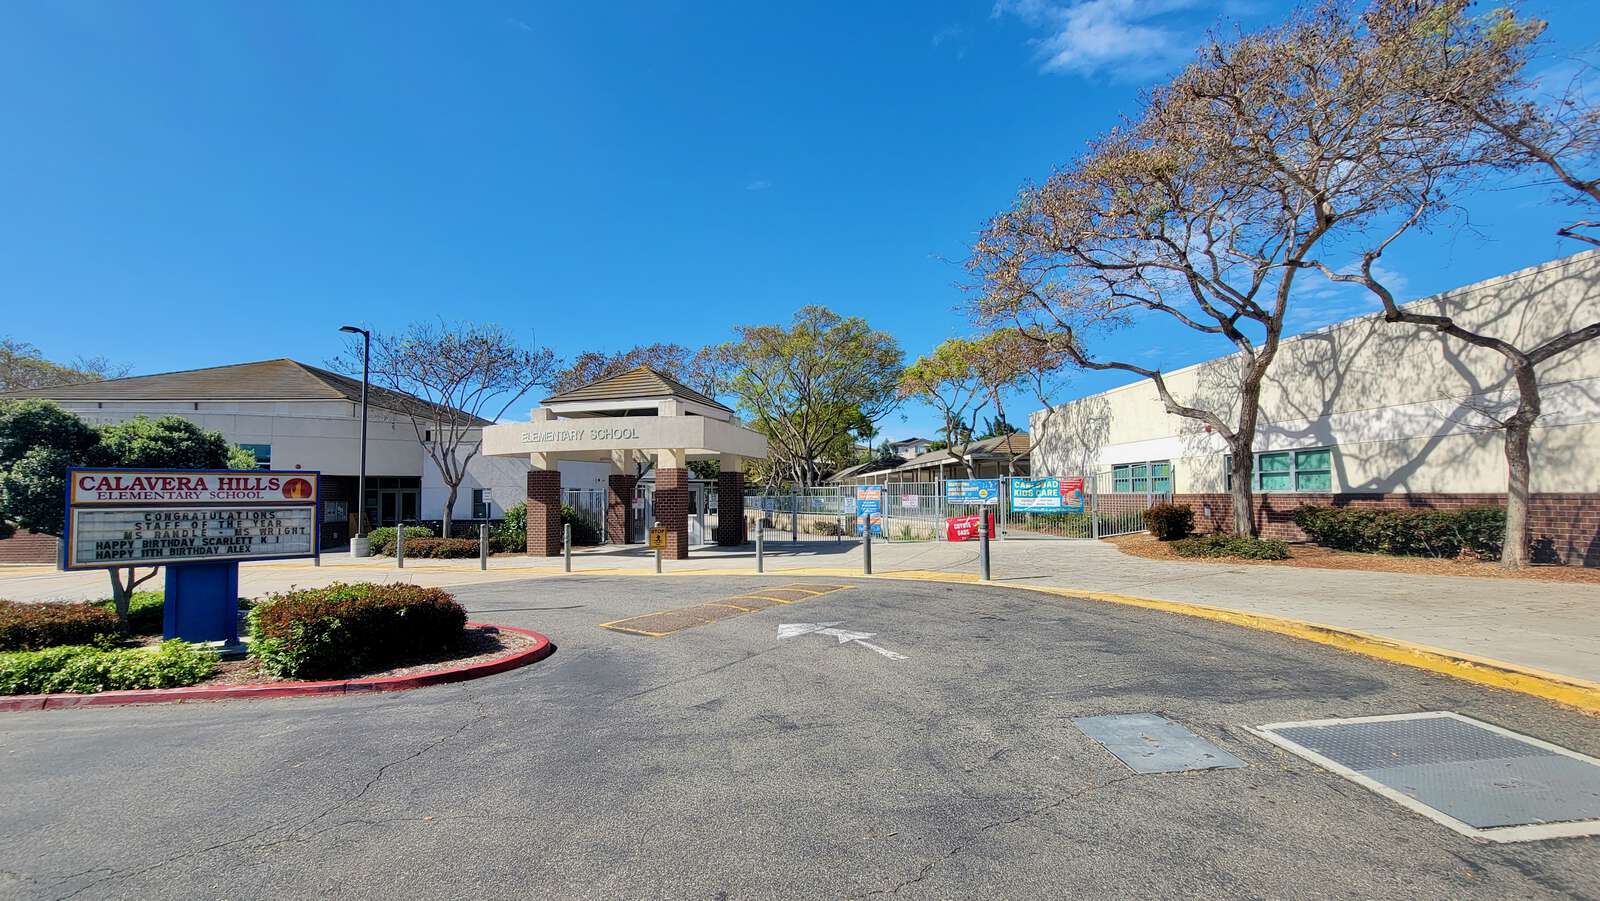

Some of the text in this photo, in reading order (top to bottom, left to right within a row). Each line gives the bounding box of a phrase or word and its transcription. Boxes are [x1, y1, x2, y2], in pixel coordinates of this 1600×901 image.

[521, 427, 640, 443] ELEMENTARY SCHOOL
[78, 476, 281, 492] CALAVERA HILLS
[97, 491, 265, 501] ELEMENTARY SCHOOL
[1014, 489, 1059, 497] KIDS CARE
[144, 511, 276, 522] CONGRATULATIONS
[135, 519, 283, 531] STAFF OF THE YEAR
[123, 530, 142, 541] MS
[154, 528, 208, 539] RANDLE
[234, 527, 250, 536] MS
[259, 526, 306, 536] WRIGHT
[95, 540, 135, 551] HAPPY
[142, 538, 196, 549] BIRTHDAY
[201, 536, 253, 546] SCARLETT
[260, 536, 267, 544] K
[95, 545, 251, 560] HAPPY 11TH BIRTHDAY ALEX
